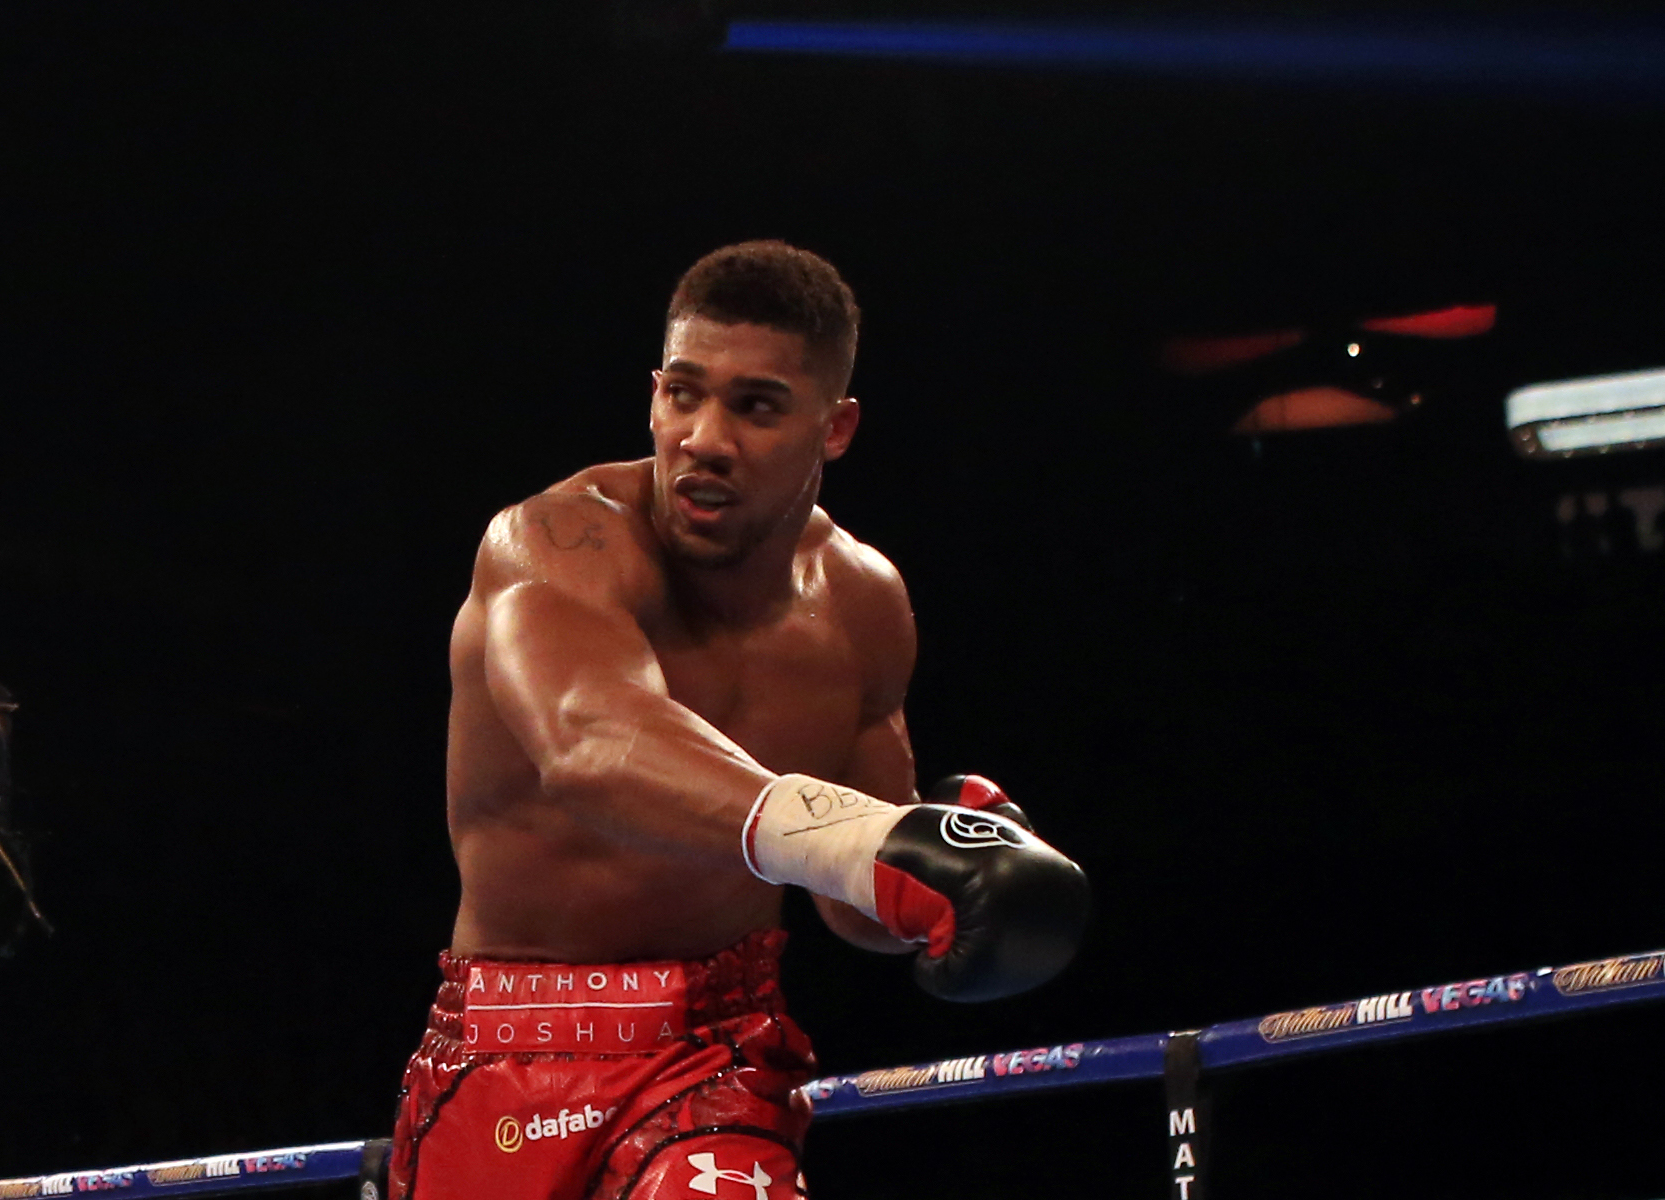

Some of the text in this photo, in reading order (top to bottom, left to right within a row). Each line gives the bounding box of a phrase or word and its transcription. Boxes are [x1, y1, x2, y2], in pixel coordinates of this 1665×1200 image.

[468, 969, 672, 994] ANTHONY
[1356, 991, 1414, 1025] HILL
[1420, 972, 1529, 1014] VEGAS
[465, 1021, 675, 1045] JOSHUA
[937, 1055, 987, 1084] HILL
[993, 1043, 1085, 1077] VEGAS
[525, 1103, 618, 1141] dafab
[205, 1157, 241, 1179] HILL
[244, 1151, 308, 1174] VEGAS
[40, 1174, 74, 1197] HILL
